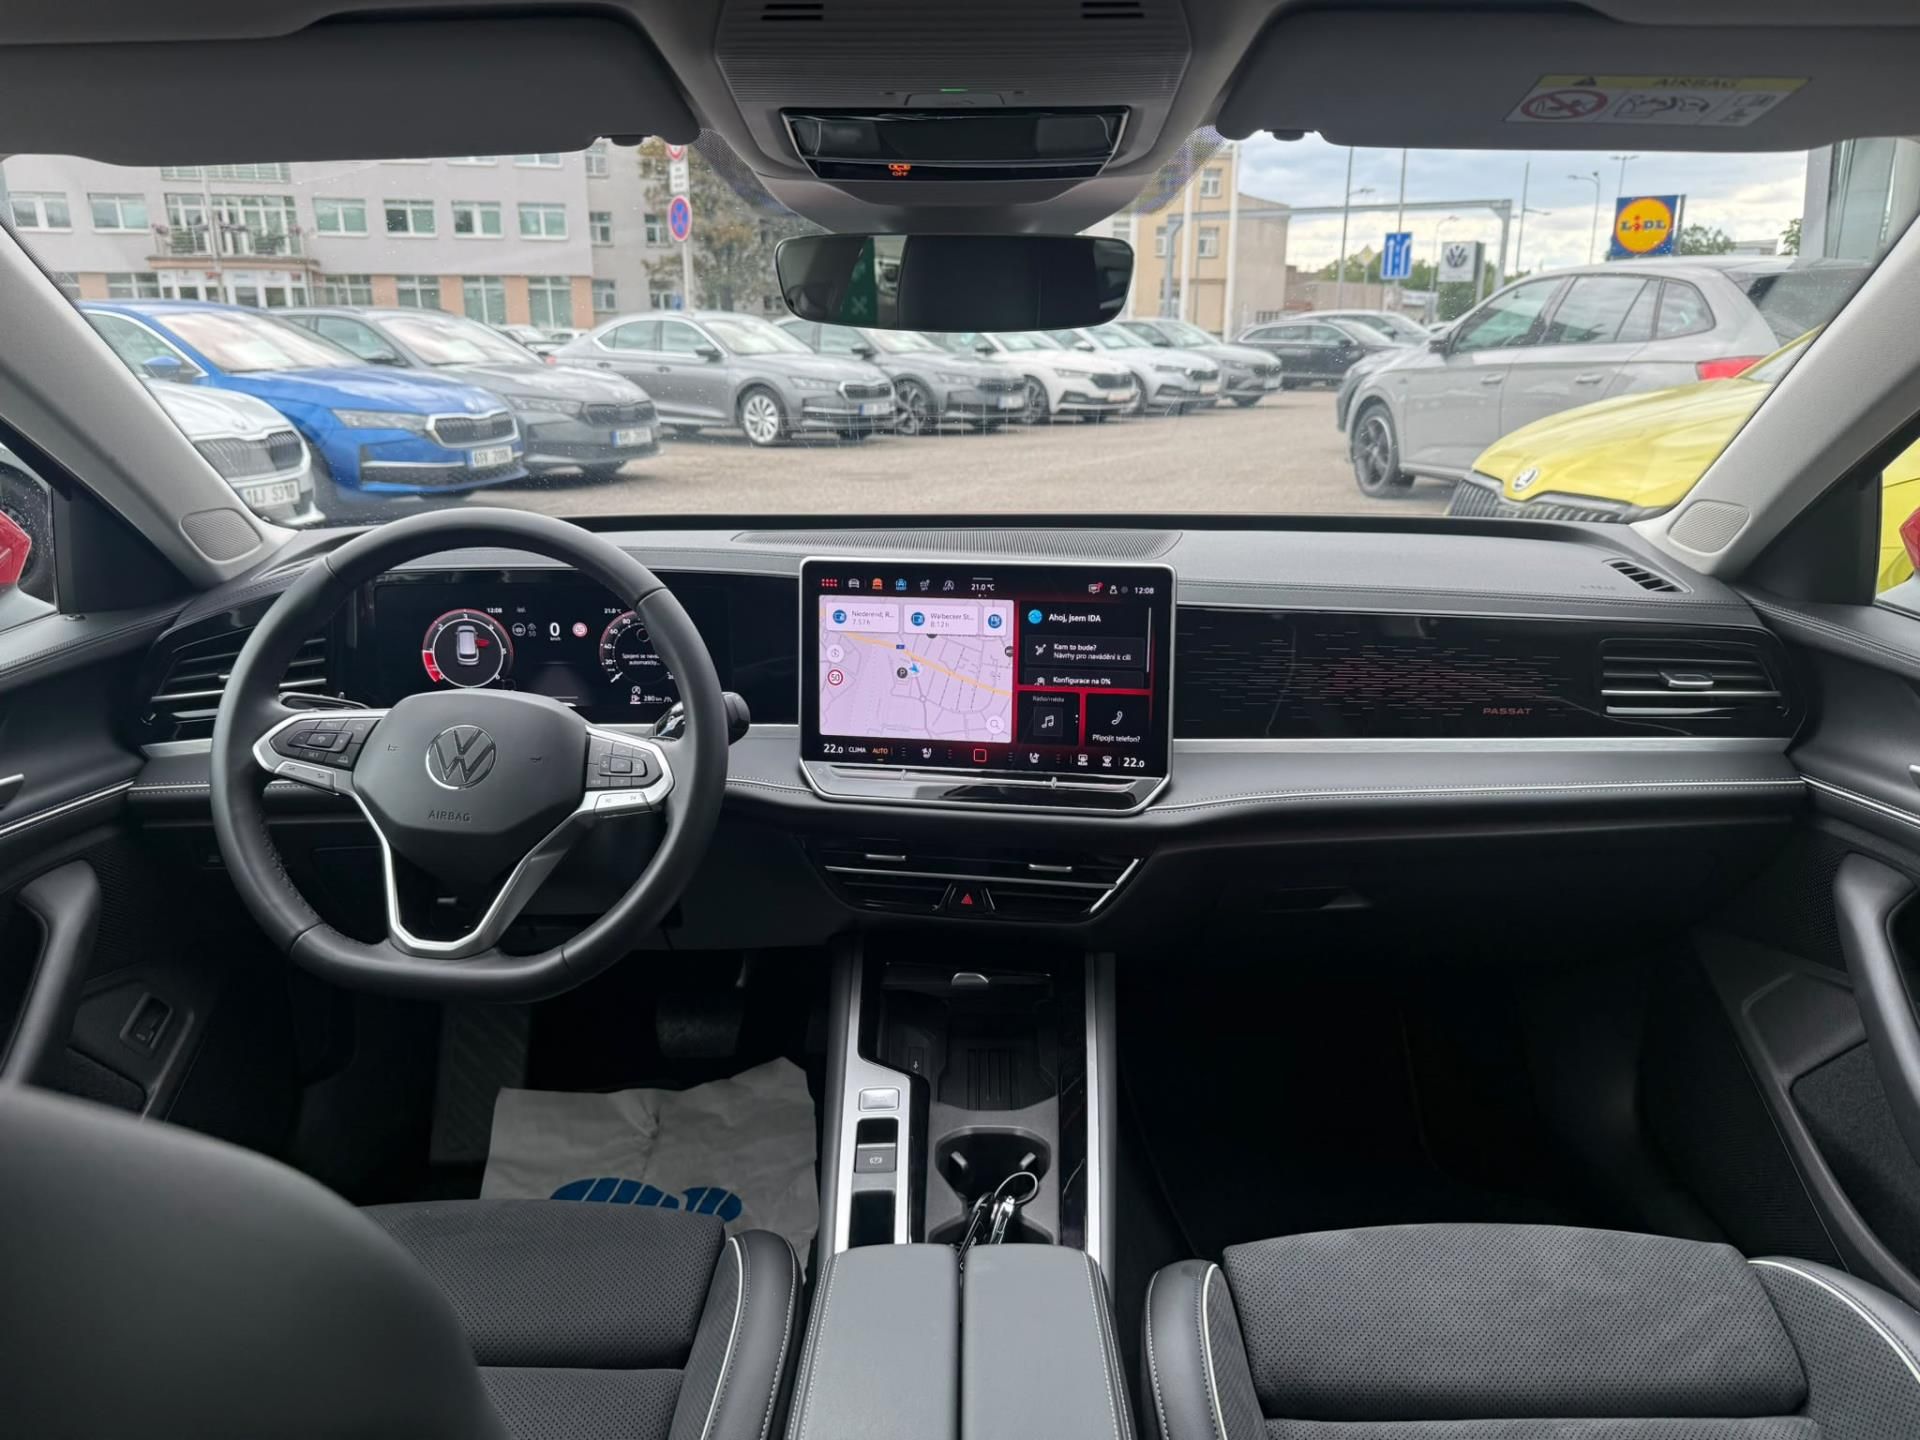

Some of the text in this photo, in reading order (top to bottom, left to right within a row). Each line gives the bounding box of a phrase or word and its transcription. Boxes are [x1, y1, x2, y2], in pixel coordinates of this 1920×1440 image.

[1134, 587, 1155, 595] 12:08
[1048, 614, 1101, 623] Ahoj, jsem IDA
[549, 622, 560, 637] 0
[1482, 707, 1533, 715] PASSAT
[428, 810, 472, 822] AIRBAG
